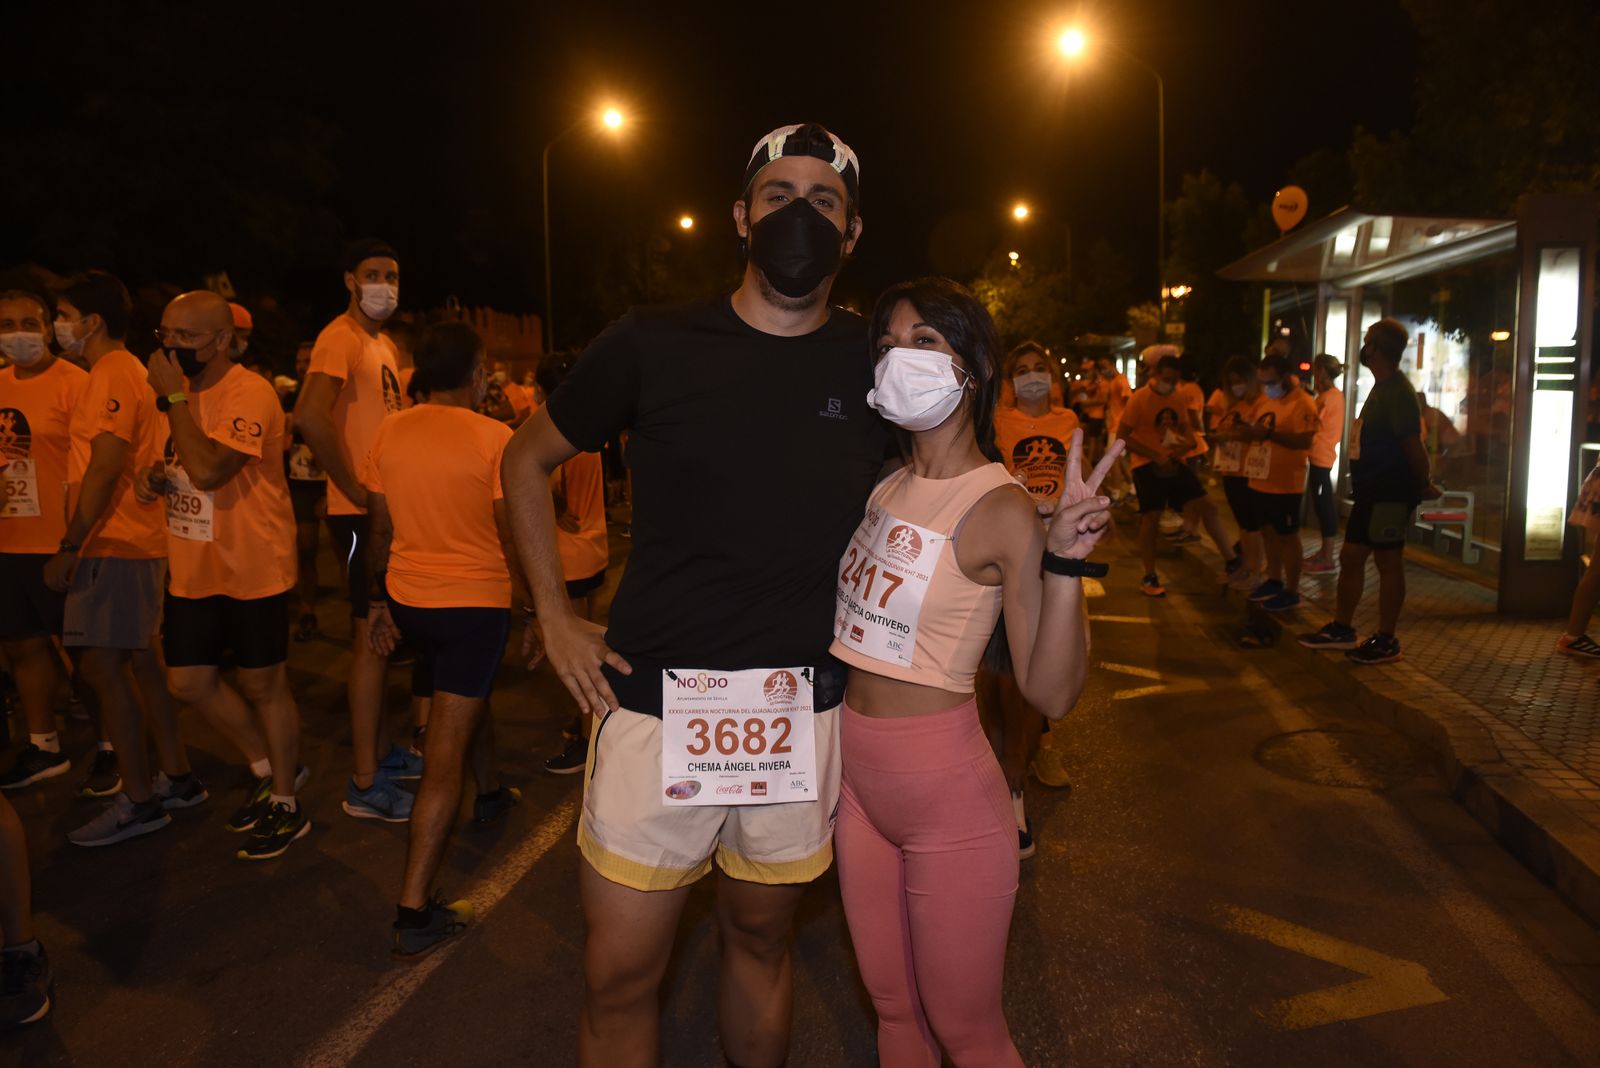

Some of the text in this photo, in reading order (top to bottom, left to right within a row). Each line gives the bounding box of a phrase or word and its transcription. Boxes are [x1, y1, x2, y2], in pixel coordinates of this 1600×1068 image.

[1027, 484, 1052, 494] KH7
[841, 547, 904, 609] 2417
[864, 611, 910, 634] ONTIVERO
[686, 716, 792, 756] 3682
[687, 759, 792, 773] CHEMA ÁNGEL RIVERA
